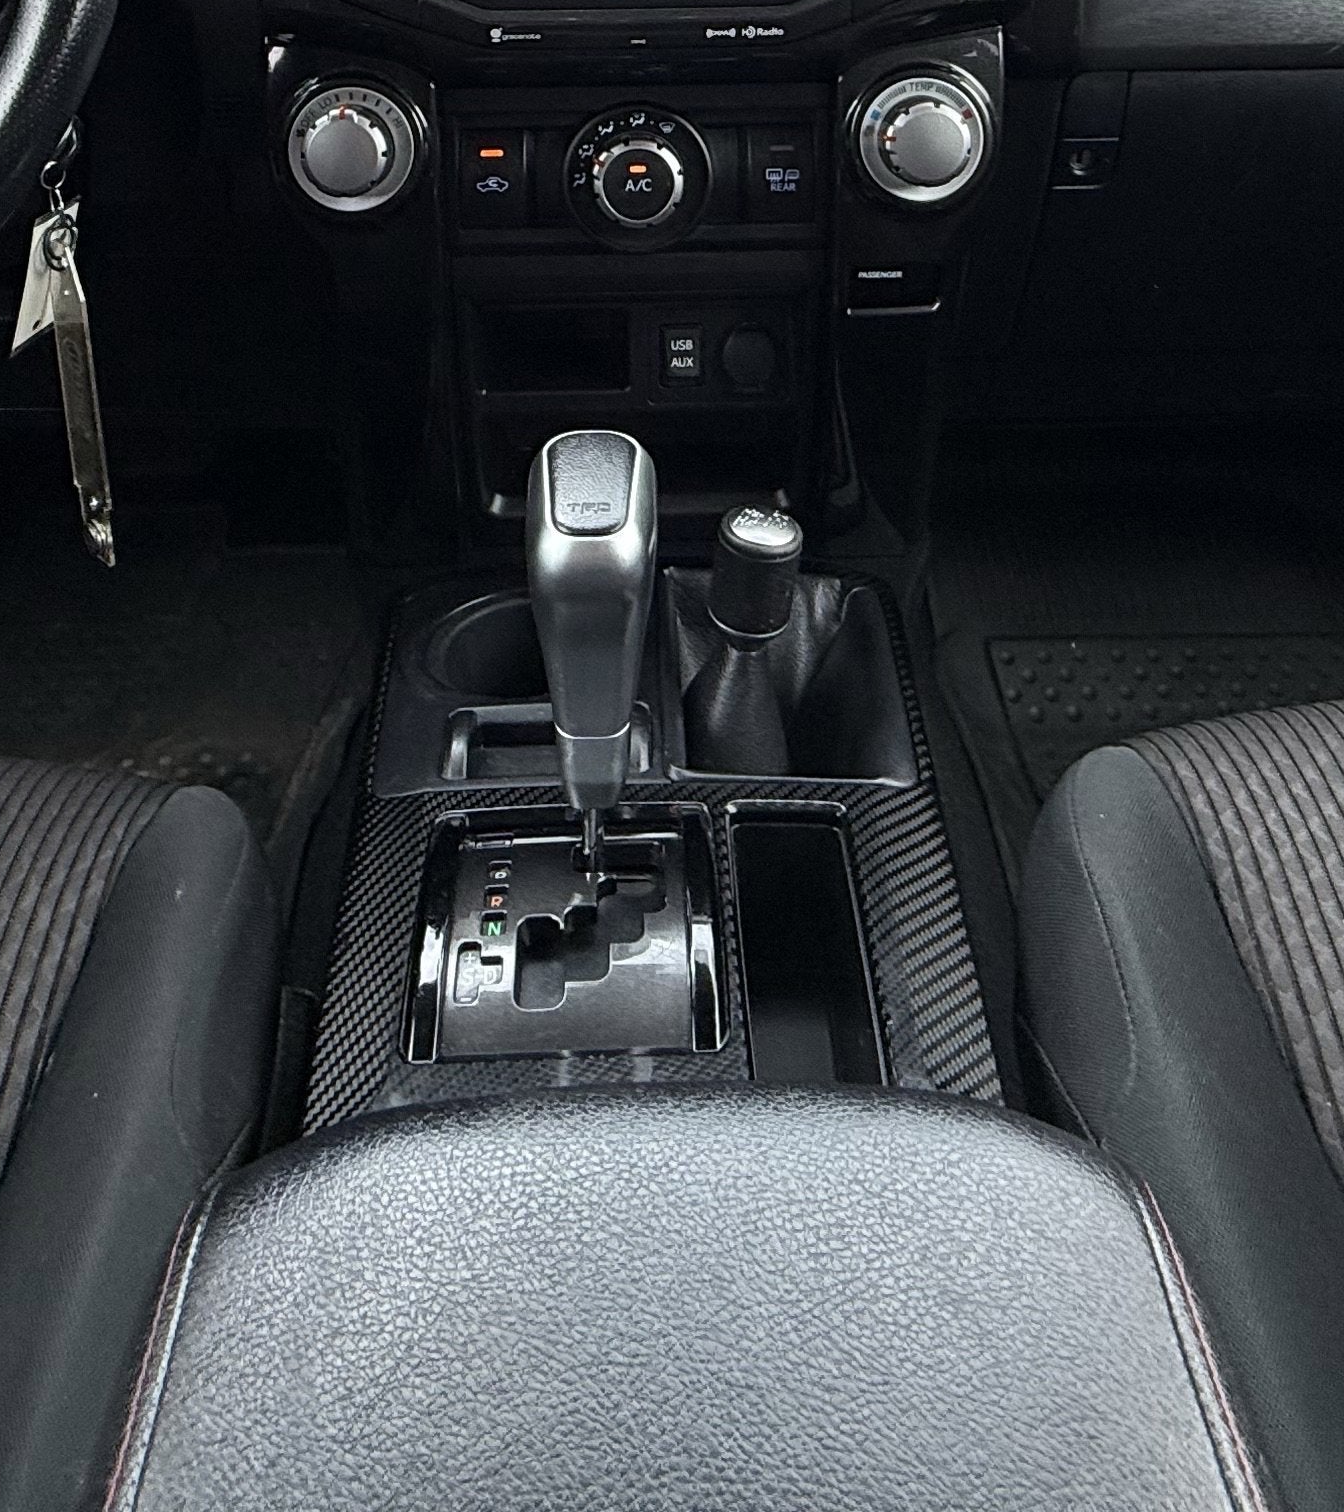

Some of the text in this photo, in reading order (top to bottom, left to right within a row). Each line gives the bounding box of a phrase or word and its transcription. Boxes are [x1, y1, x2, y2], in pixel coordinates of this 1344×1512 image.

[757, 27, 785, 37] Radio
[908, 81, 935, 92] TEMP
[624, 178, 653, 192] A/C
[770, 180, 797, 192] REAR
[670, 339, 694, 351] USB
[670, 357, 694, 368] AUX
[567, 501, 611, 515] TRD
[490, 896, 504, 908] R
[487, 921, 501, 936] N
